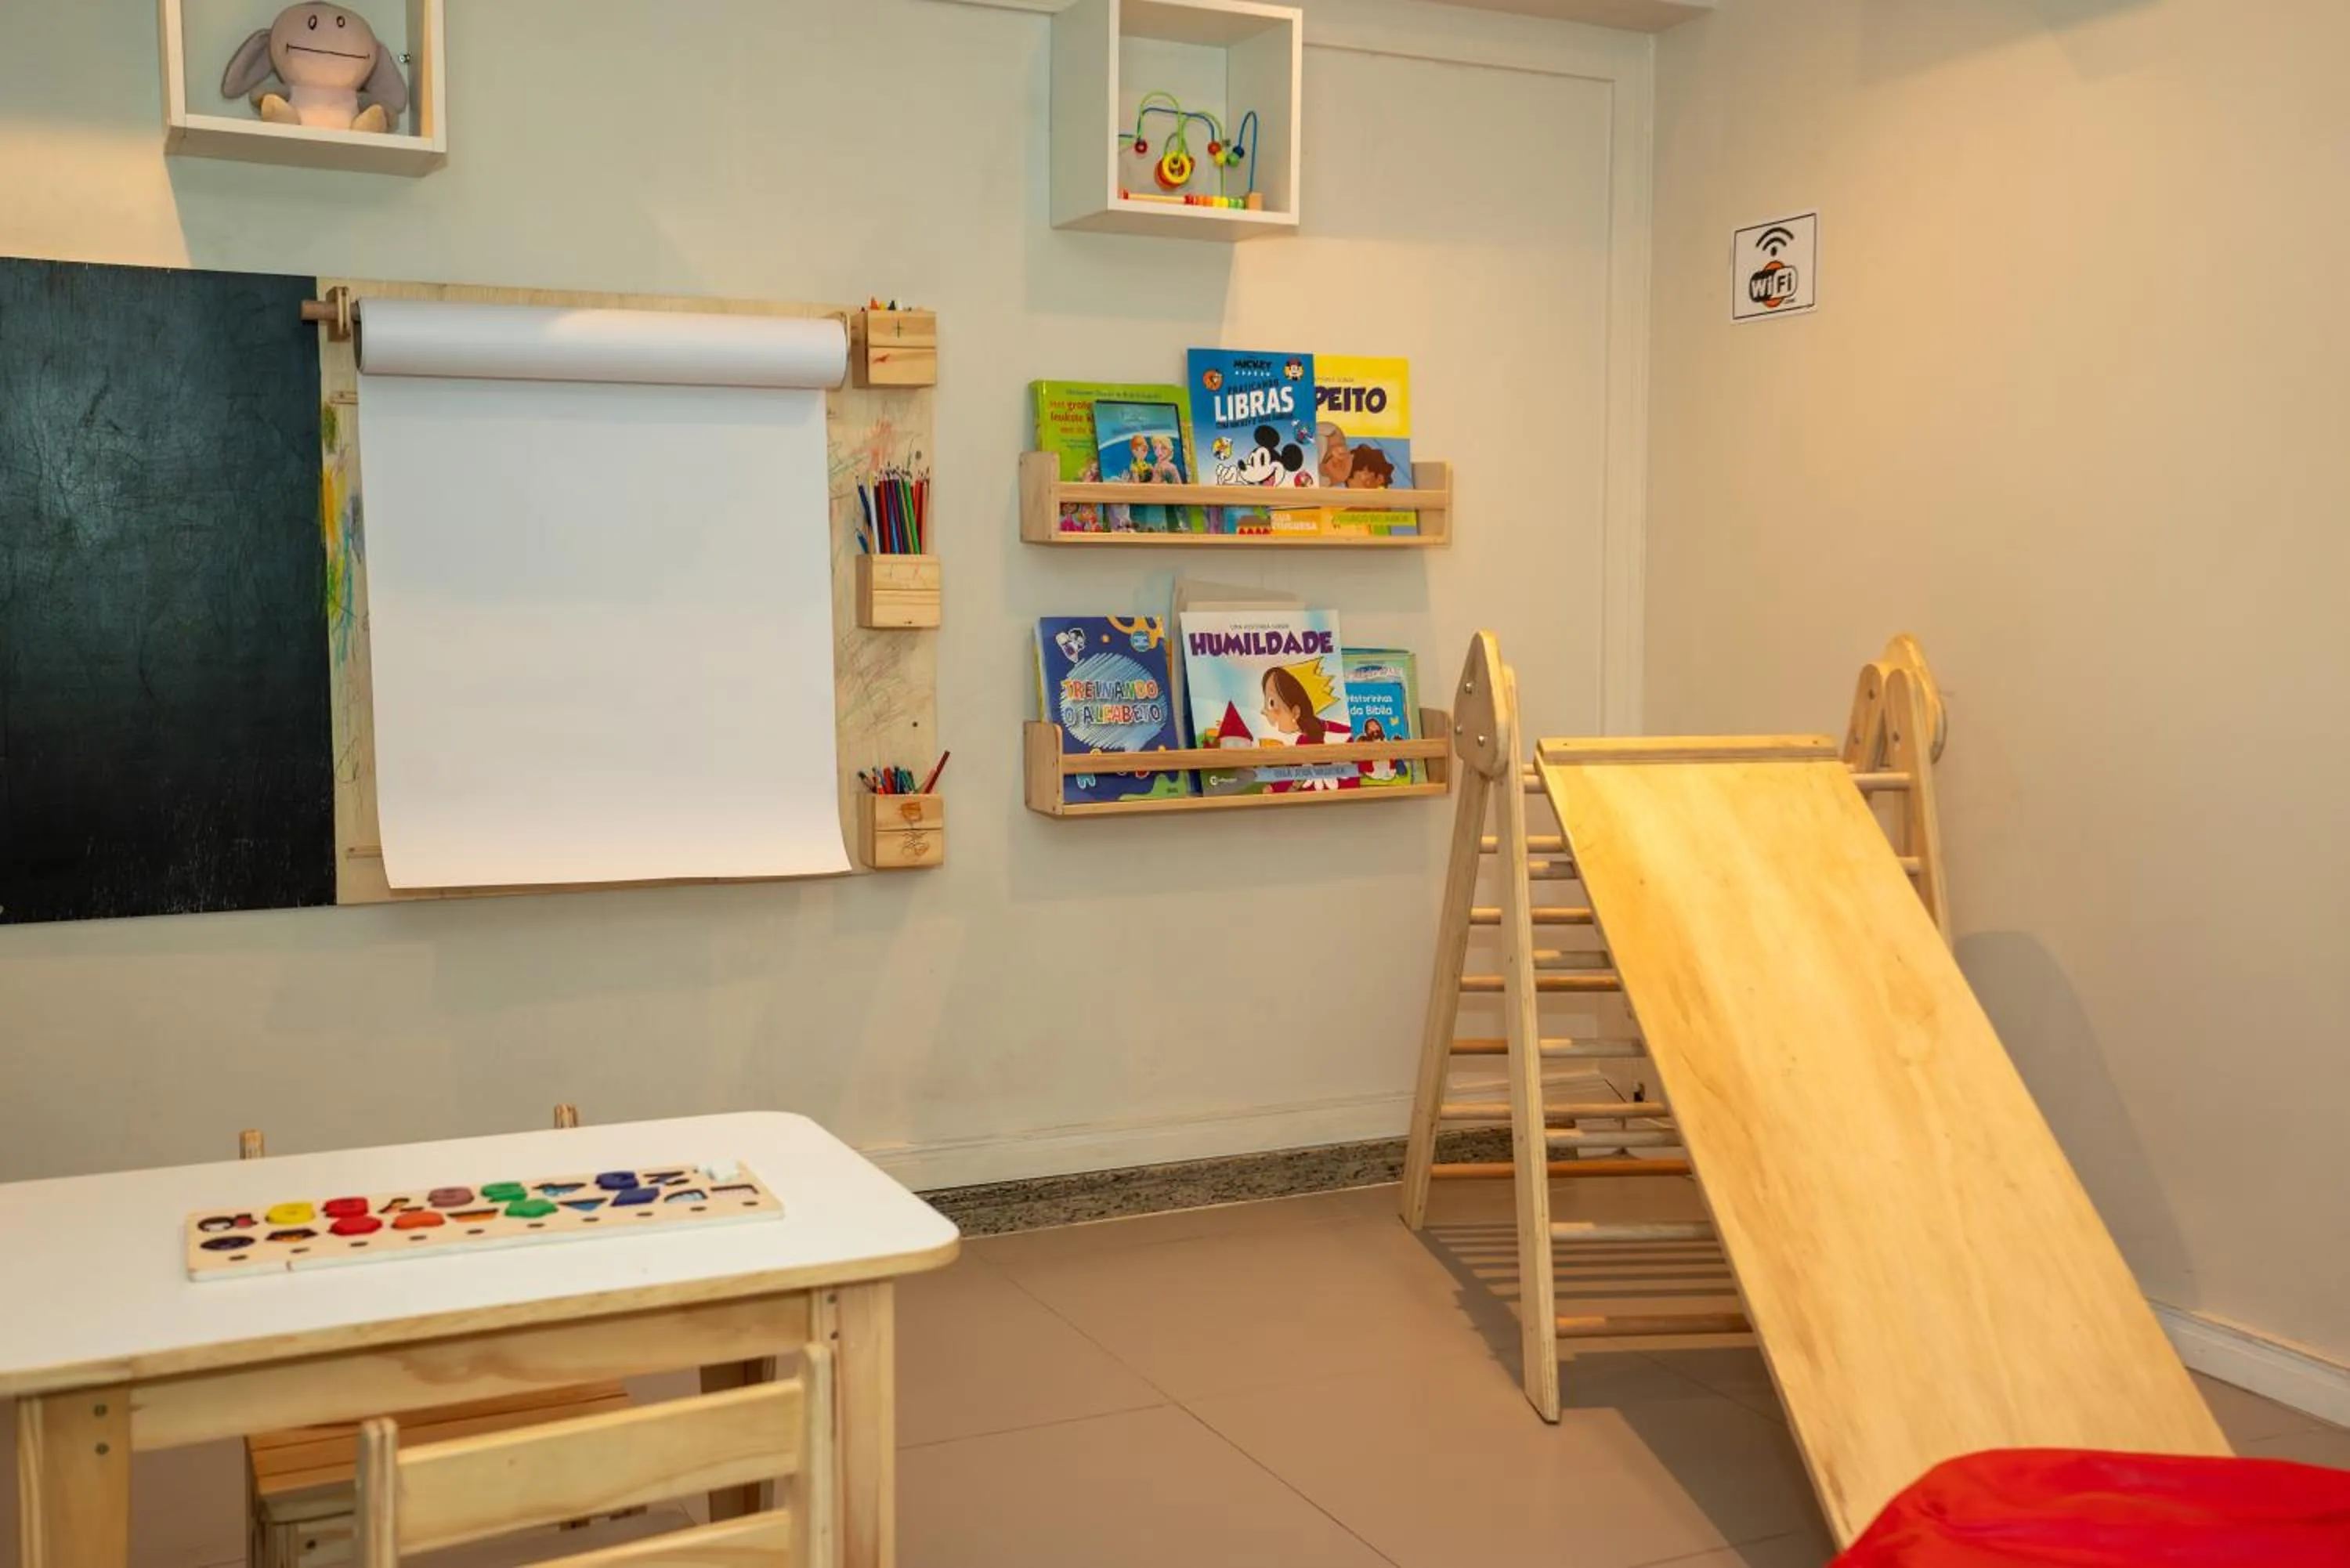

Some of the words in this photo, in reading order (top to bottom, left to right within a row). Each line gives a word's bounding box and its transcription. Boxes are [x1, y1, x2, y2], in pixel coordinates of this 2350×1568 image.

[1751, 272, 1792, 298] WiFi
[1214, 385, 1295, 423] LIBRAS
[1314, 386, 1387, 414] PEITO
[1189, 630, 1334, 657] HUMILDADE
[1061, 678, 1159, 702] TREINANDO
[1062, 706, 1076, 725] O
[1083, 703, 1163, 724] ALFABETO
